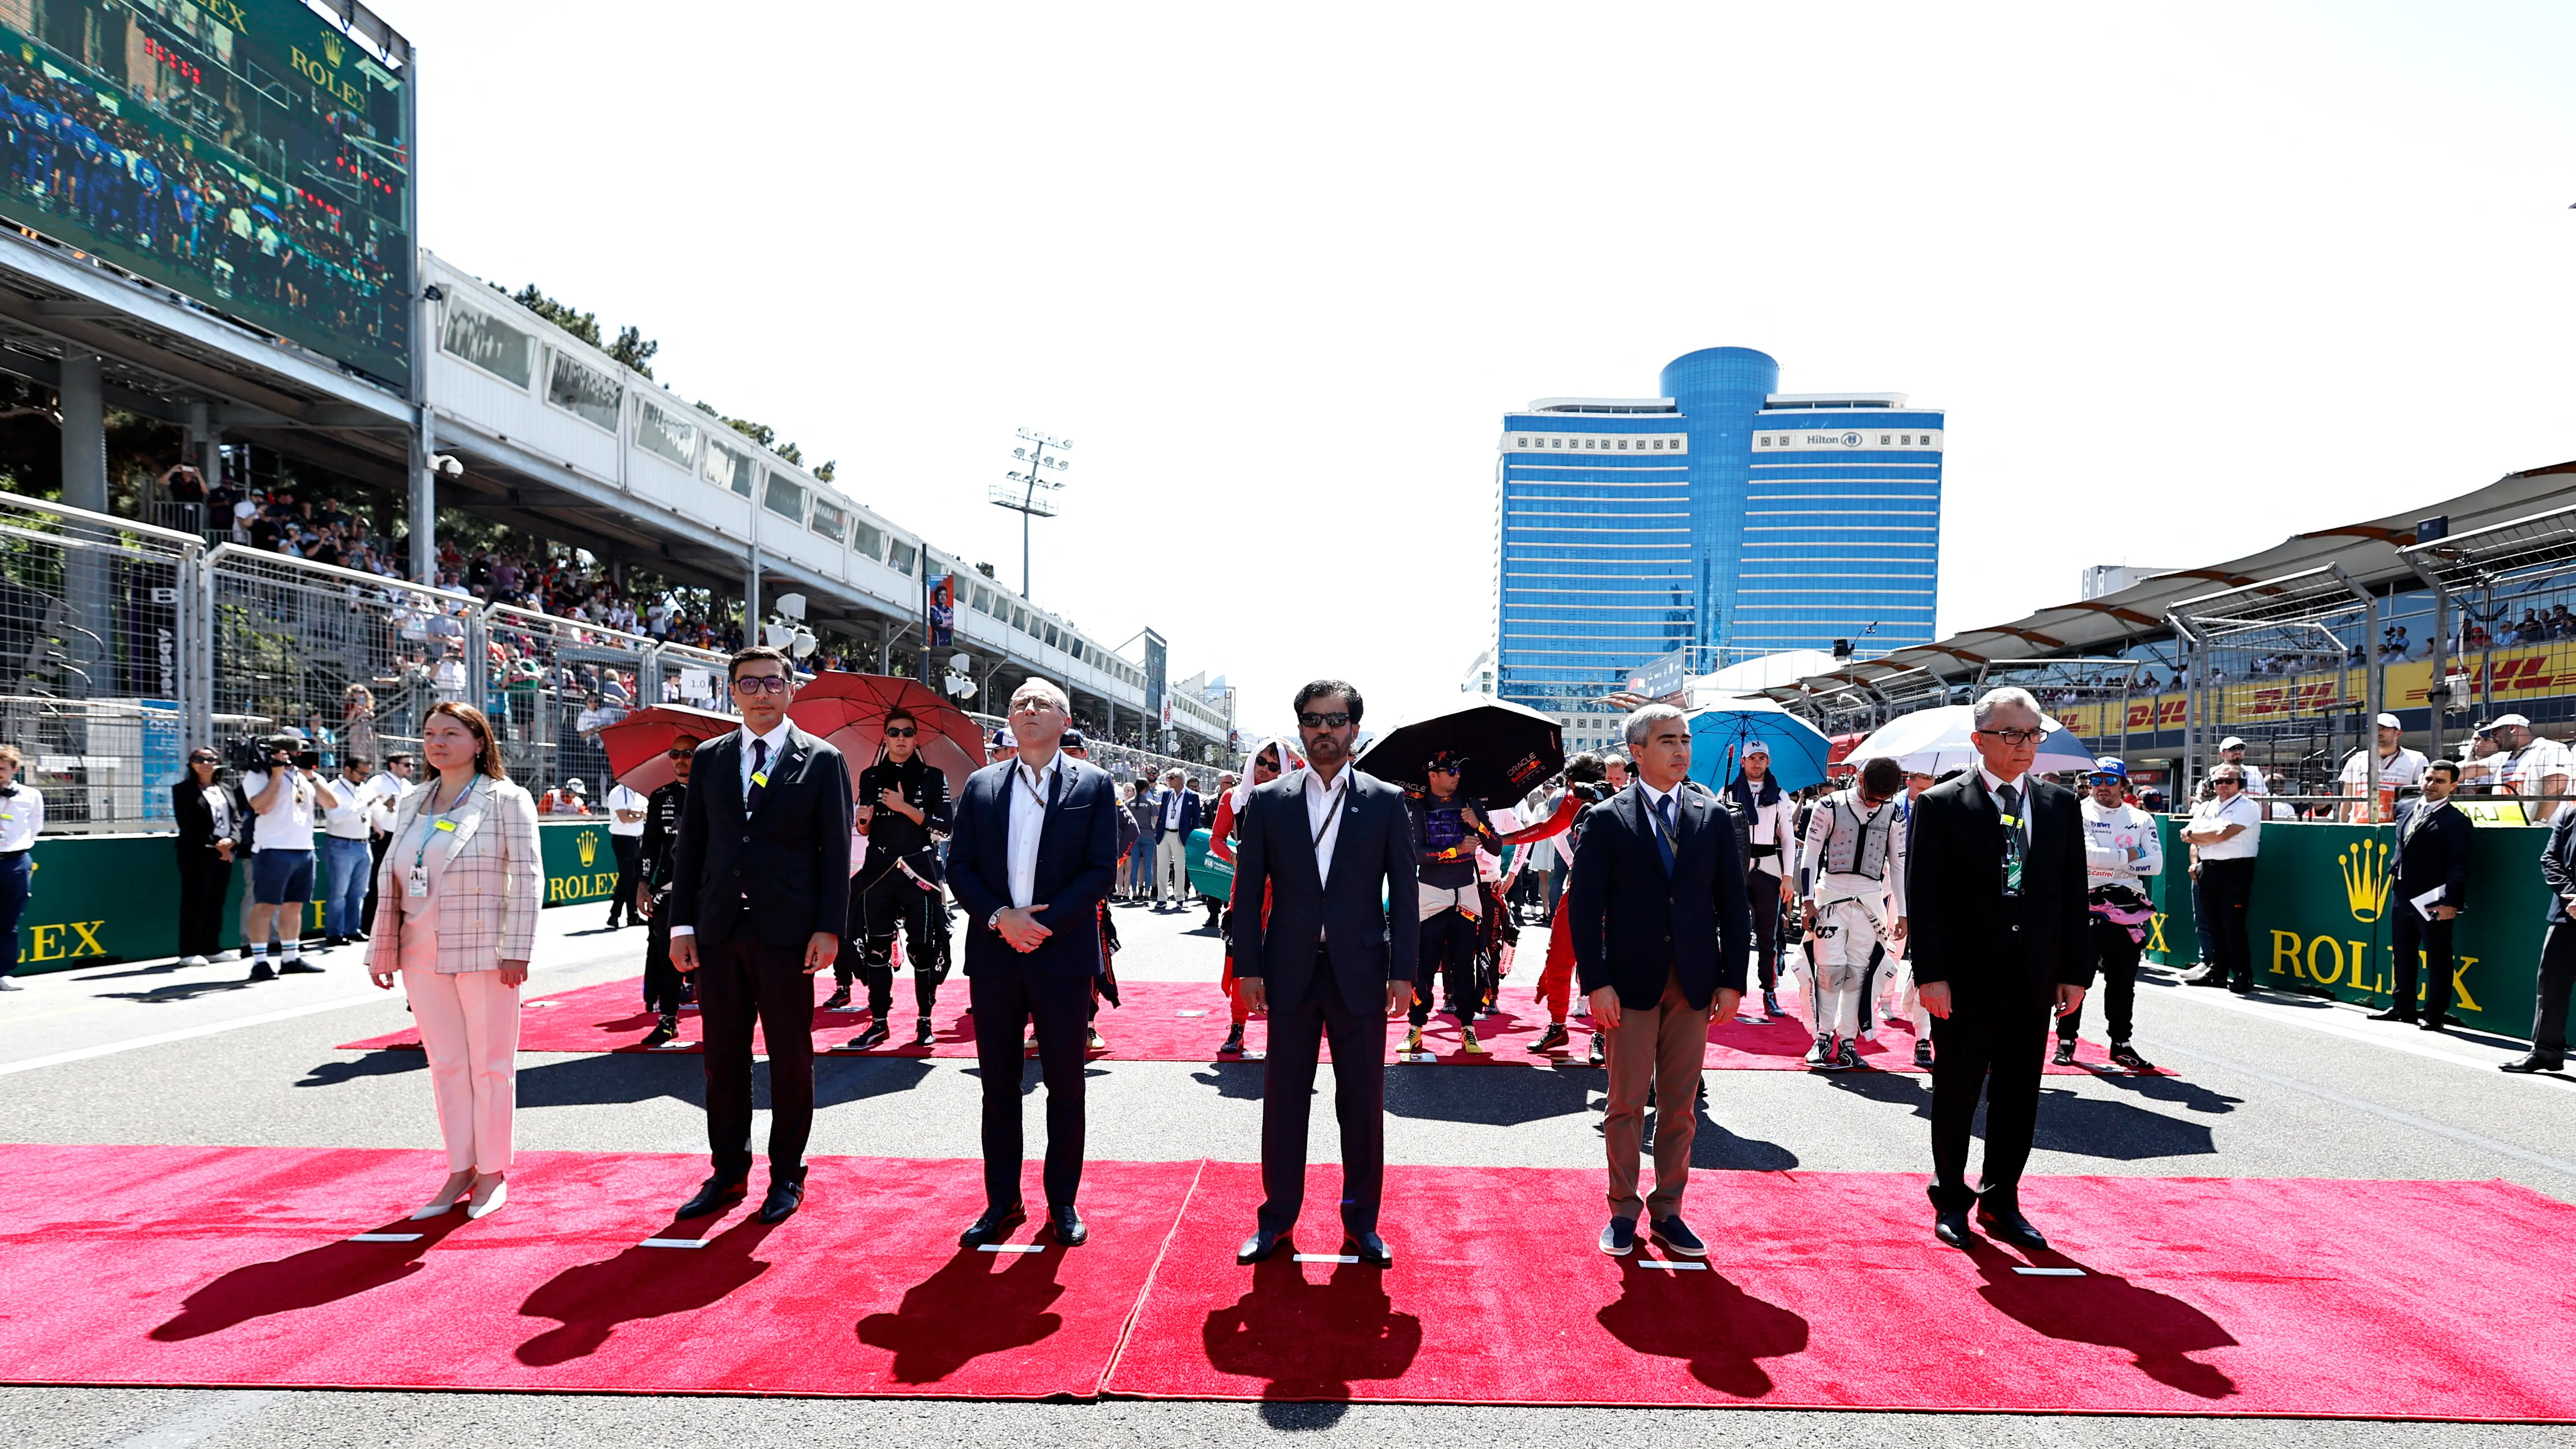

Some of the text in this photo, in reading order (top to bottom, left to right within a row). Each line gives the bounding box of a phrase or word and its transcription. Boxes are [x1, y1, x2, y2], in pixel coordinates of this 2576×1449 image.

[1807, 435, 1838, 444] Hilton
[691, 679, 705, 688] 1.0
[2252, 682, 2343, 714] DHL
[2128, 700, 2188, 727] DHL
[1507, 752, 1536, 777] ORACLE
[1391, 780, 1427, 793] ORACLE
[1517, 766, 1546, 788] RACING
[926, 826, 948, 838] INEOS
[549, 872, 619, 901] ROLEX
